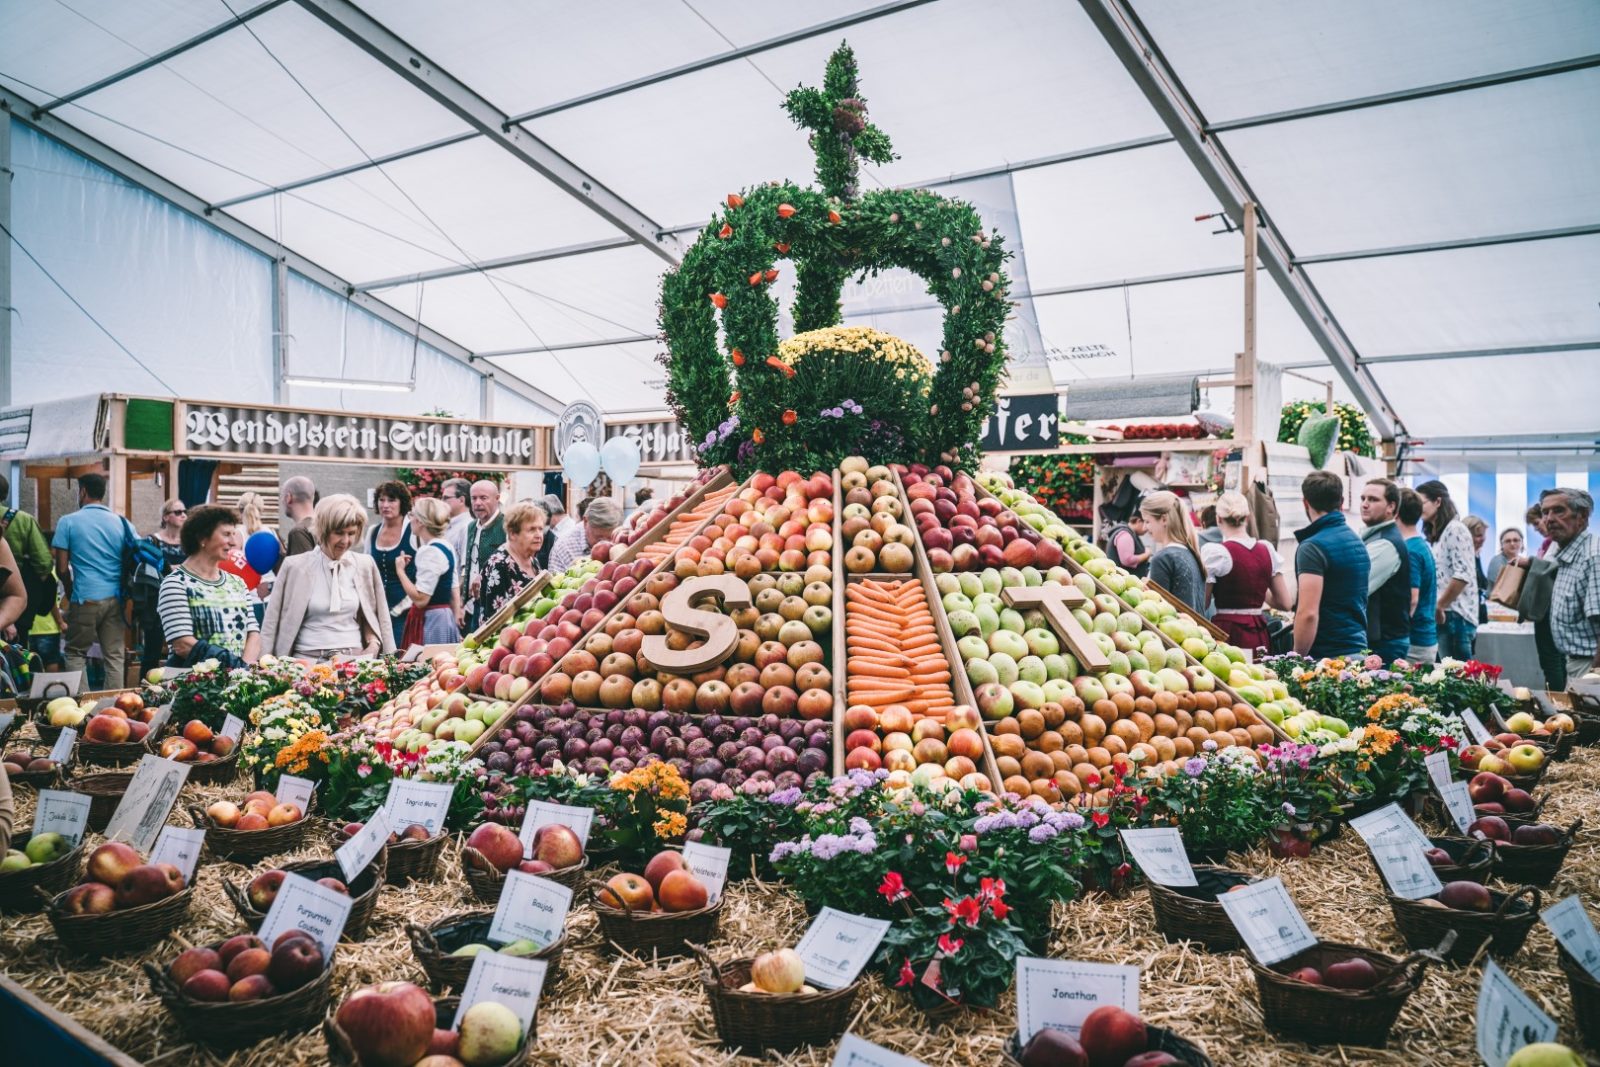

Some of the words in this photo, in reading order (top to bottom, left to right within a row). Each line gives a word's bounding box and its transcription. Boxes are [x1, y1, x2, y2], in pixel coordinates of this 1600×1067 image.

[186, 411, 533, 461] Wendelstein-Schafwolle
[641, 574, 752, 674] S
[1001, 585, 1111, 673] T
[1052, 988, 1098, 1001] Jonathan
